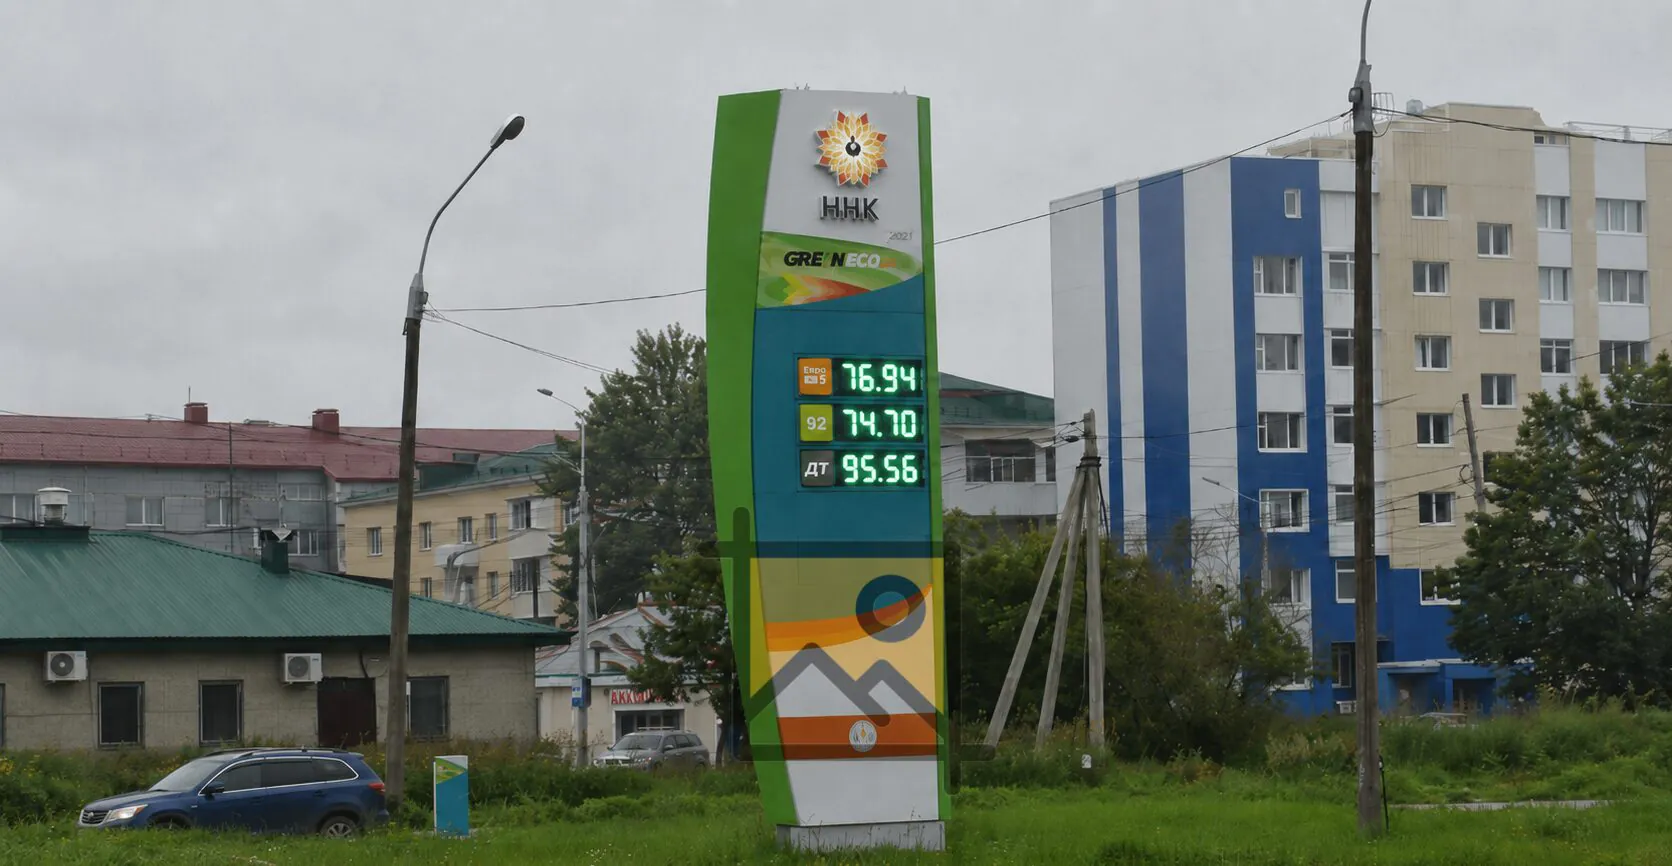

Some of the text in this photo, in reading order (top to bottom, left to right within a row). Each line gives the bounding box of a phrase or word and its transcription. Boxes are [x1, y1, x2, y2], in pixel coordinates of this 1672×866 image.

[821, 195, 880, 221] ННК
[841, 362, 916, 392] 76.94
[806, 408, 917, 438] 92 74.70
[804, 453, 919, 483] ДТ 95.56
